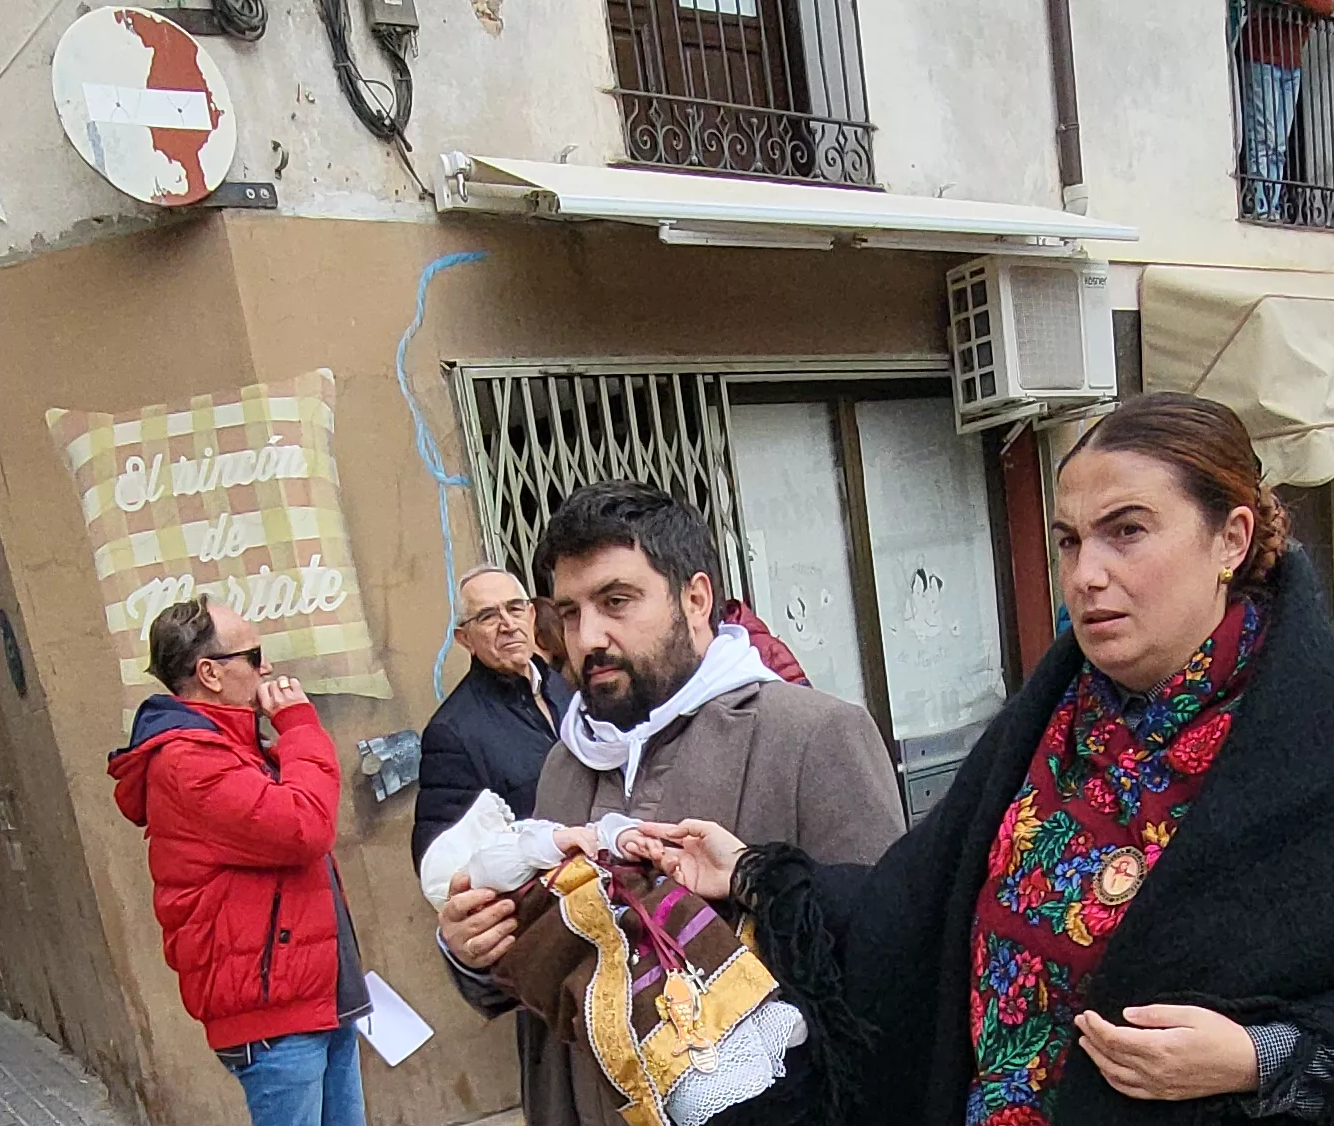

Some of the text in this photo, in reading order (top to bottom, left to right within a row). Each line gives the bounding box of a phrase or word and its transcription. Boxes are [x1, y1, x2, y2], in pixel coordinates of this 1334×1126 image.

[115, 434, 308, 512] El rincón
[199, 512, 248, 562] de
[126, 554, 348, 641] Mriate
